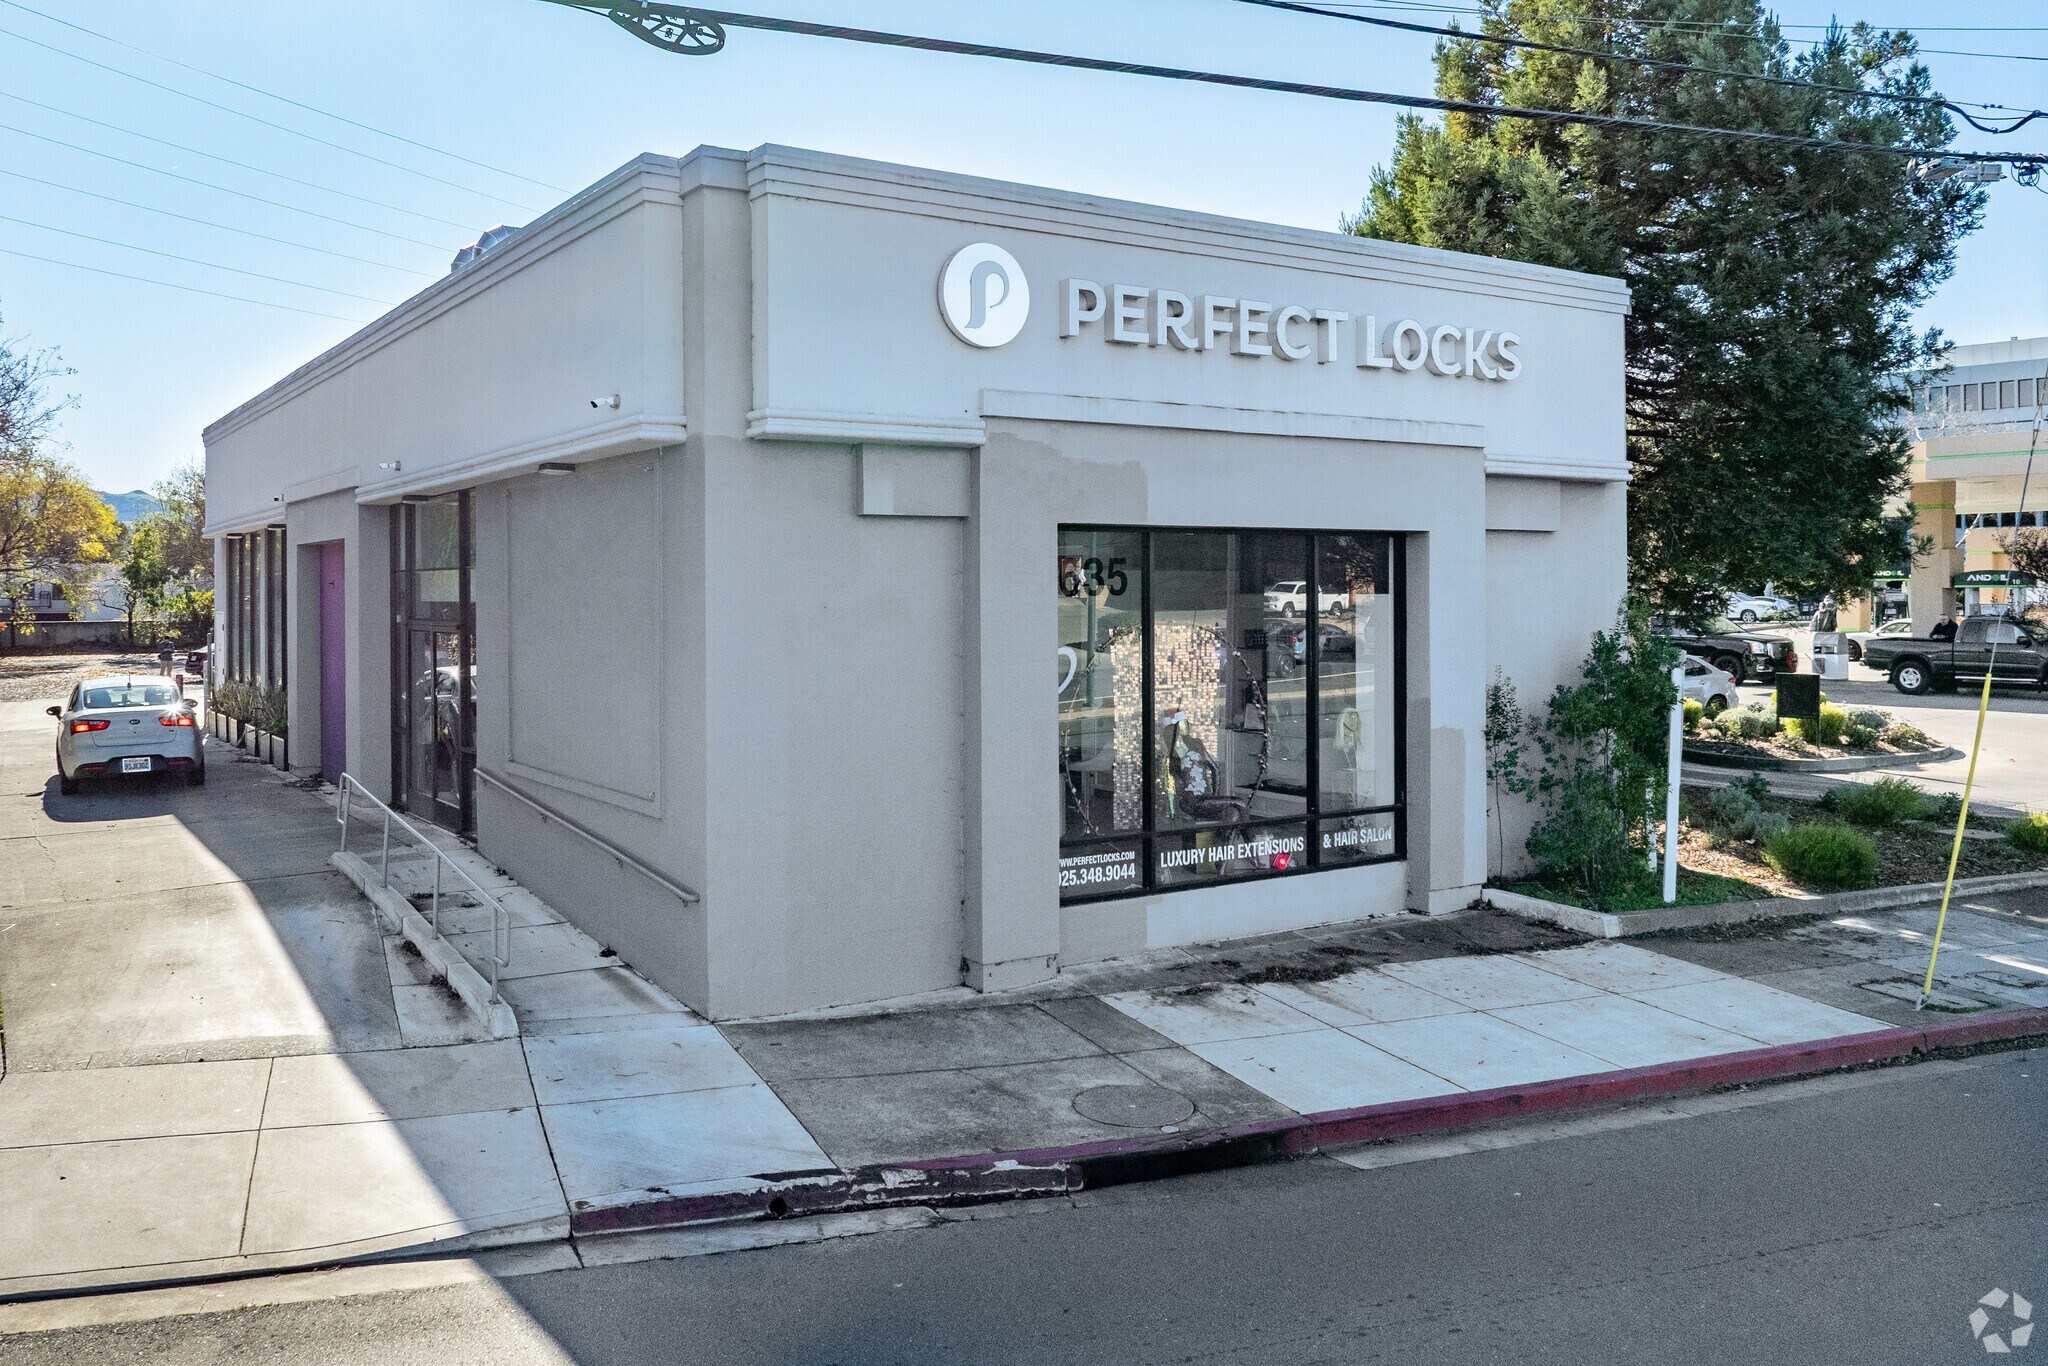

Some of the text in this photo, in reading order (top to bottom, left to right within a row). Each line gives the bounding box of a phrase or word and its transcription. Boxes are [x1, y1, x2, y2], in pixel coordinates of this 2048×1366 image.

[1060, 278, 1522, 382] PERFECT LOCKS
[1059, 557, 1128, 597] 635
[1060, 851, 1135, 867] WW.PERFECTLOCKS.COM
[1160, 826, 1392, 868] LUXURY HAIR EXTENSIONS & HAIR SALON
